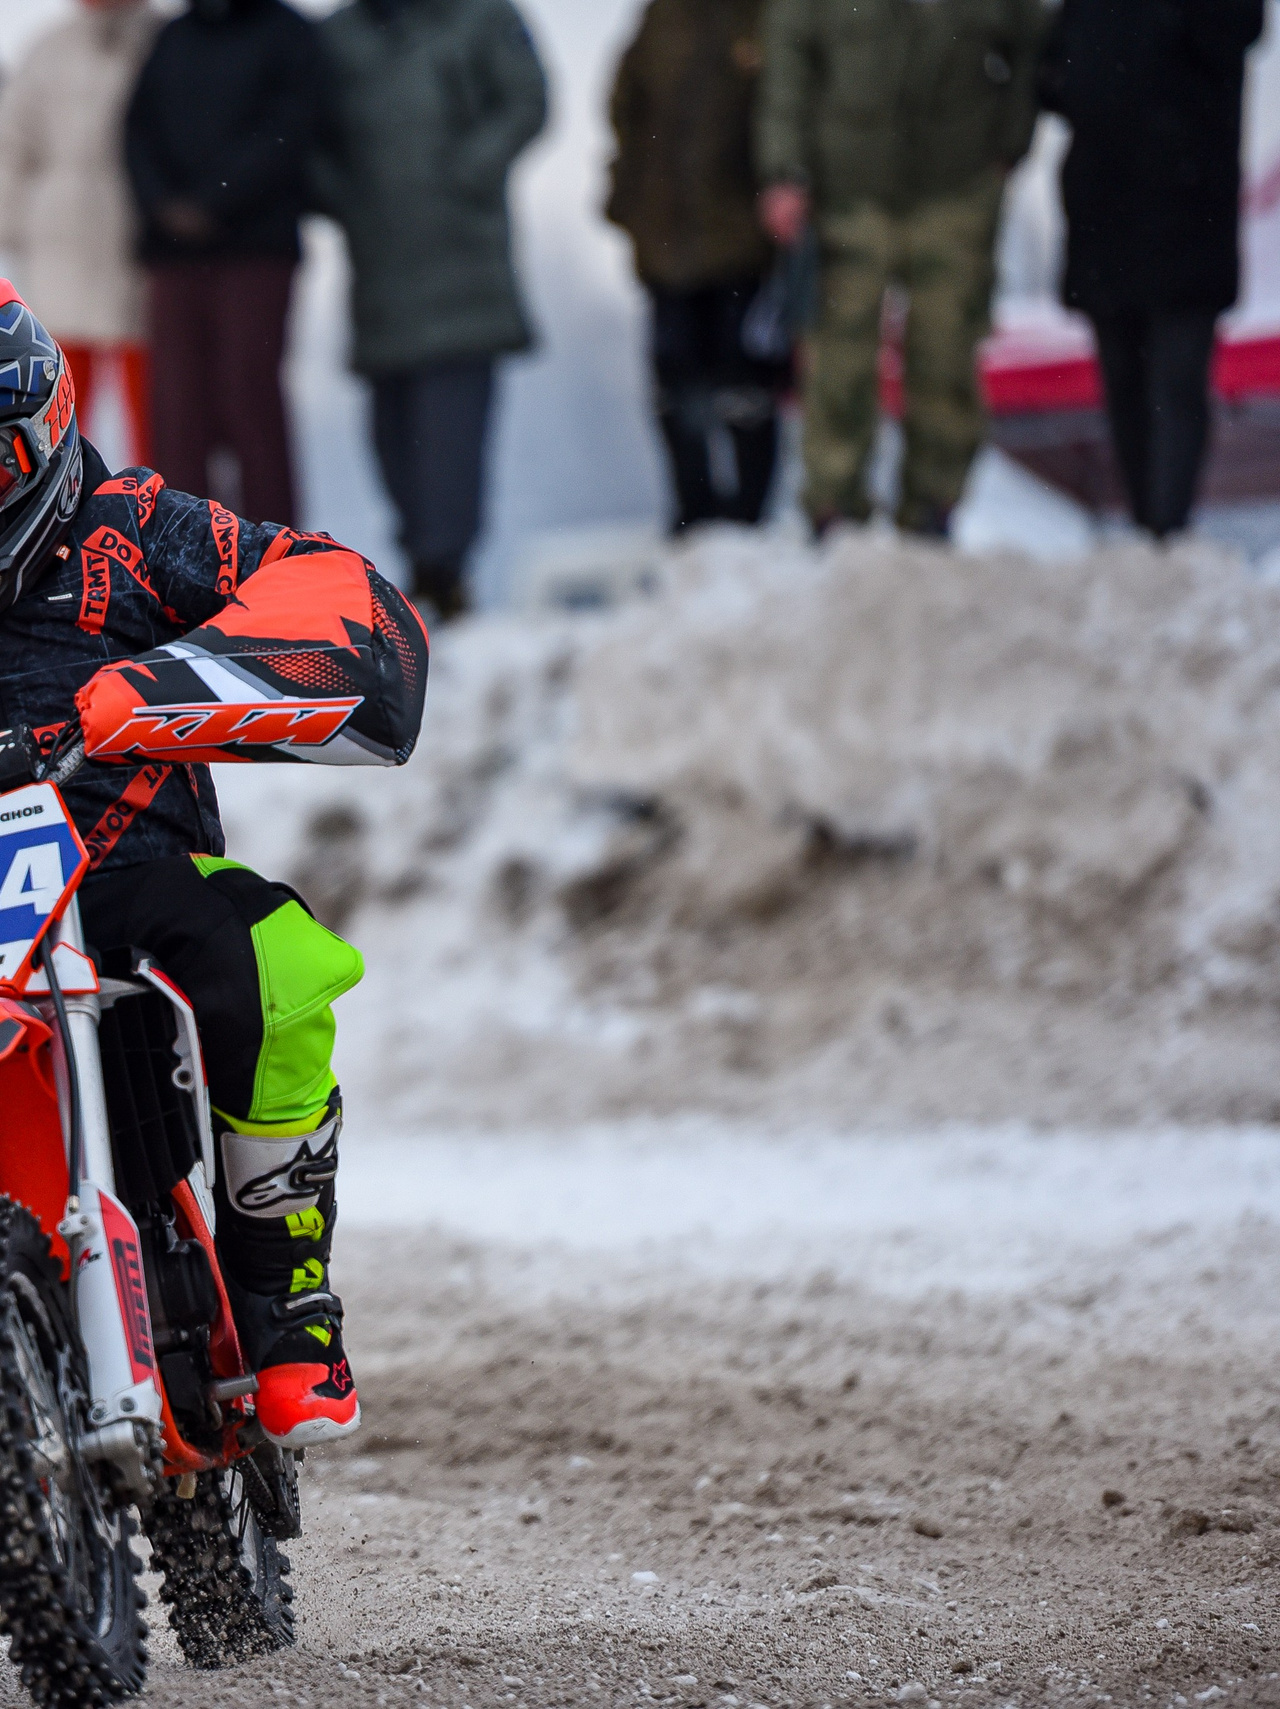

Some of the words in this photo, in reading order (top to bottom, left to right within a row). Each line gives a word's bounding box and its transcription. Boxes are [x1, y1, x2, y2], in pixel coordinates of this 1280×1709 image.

[98, 531, 132, 562] DO
[84, 554, 109, 618] TRMT
[87, 696, 366, 758] KTM
